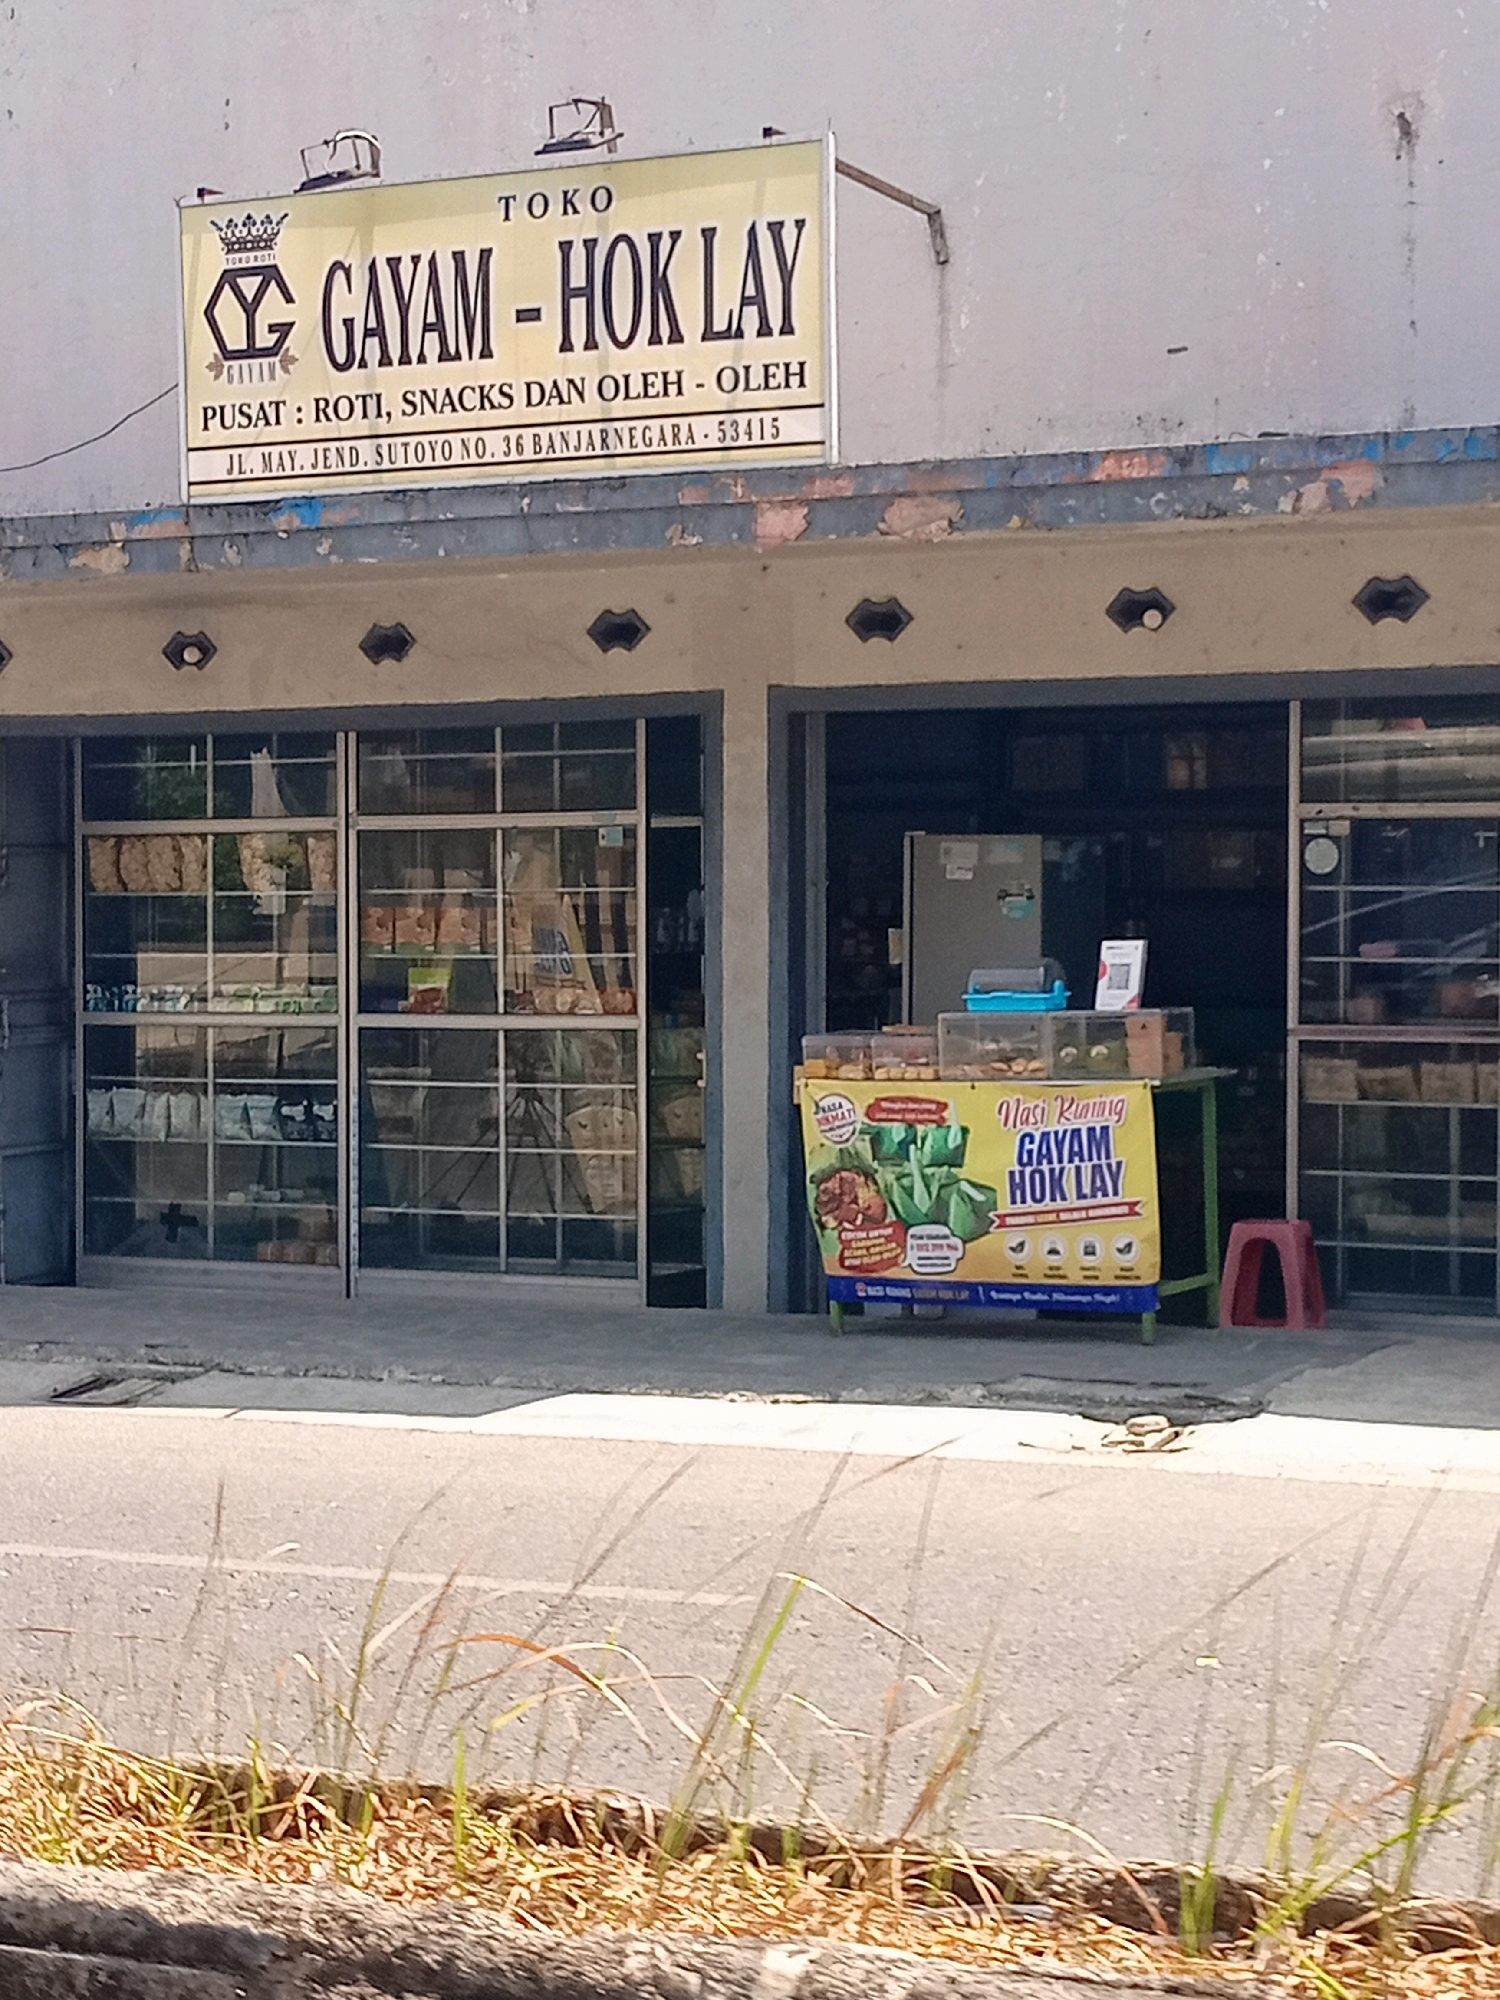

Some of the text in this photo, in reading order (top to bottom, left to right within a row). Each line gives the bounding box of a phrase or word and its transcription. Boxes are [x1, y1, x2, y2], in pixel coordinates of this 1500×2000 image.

[498, 186, 613, 222] TOKO
[253, 253, 277, 263] ROTI
[322, 247, 494, 373] GAYAM
[558, 230, 685, 353] HOK
[700, 218, 807, 343] LAY
[227, 362, 277, 385] GAYAM
[202, 400, 287, 432] PUSAT
[313, 393, 392, 424] ROTI,
[401, 382, 514, 417] SNACKS
[524, 377, 586, 408] DAN
[597, 370, 685, 403] OLEH
[716, 361, 807, 394] OLEH
[226, 453, 254, 476] JL.
[262, 450, 305, 474] MAY.
[311, 446, 369, 471] JEND.
[375, 439, 452, 467] SUTOYO
[461, 437, 495, 460] NO.
[503, 435, 525, 458] 36
[532, 423, 696, 456] BANJARNEGARA
[717, 417, 781, 444] 53415
[998, 1094, 1126, 1128] Nasi Kuning
[1017, 1125, 1112, 1168] GAYAM
[1008, 1160, 1124, 1206] HOK LAY
